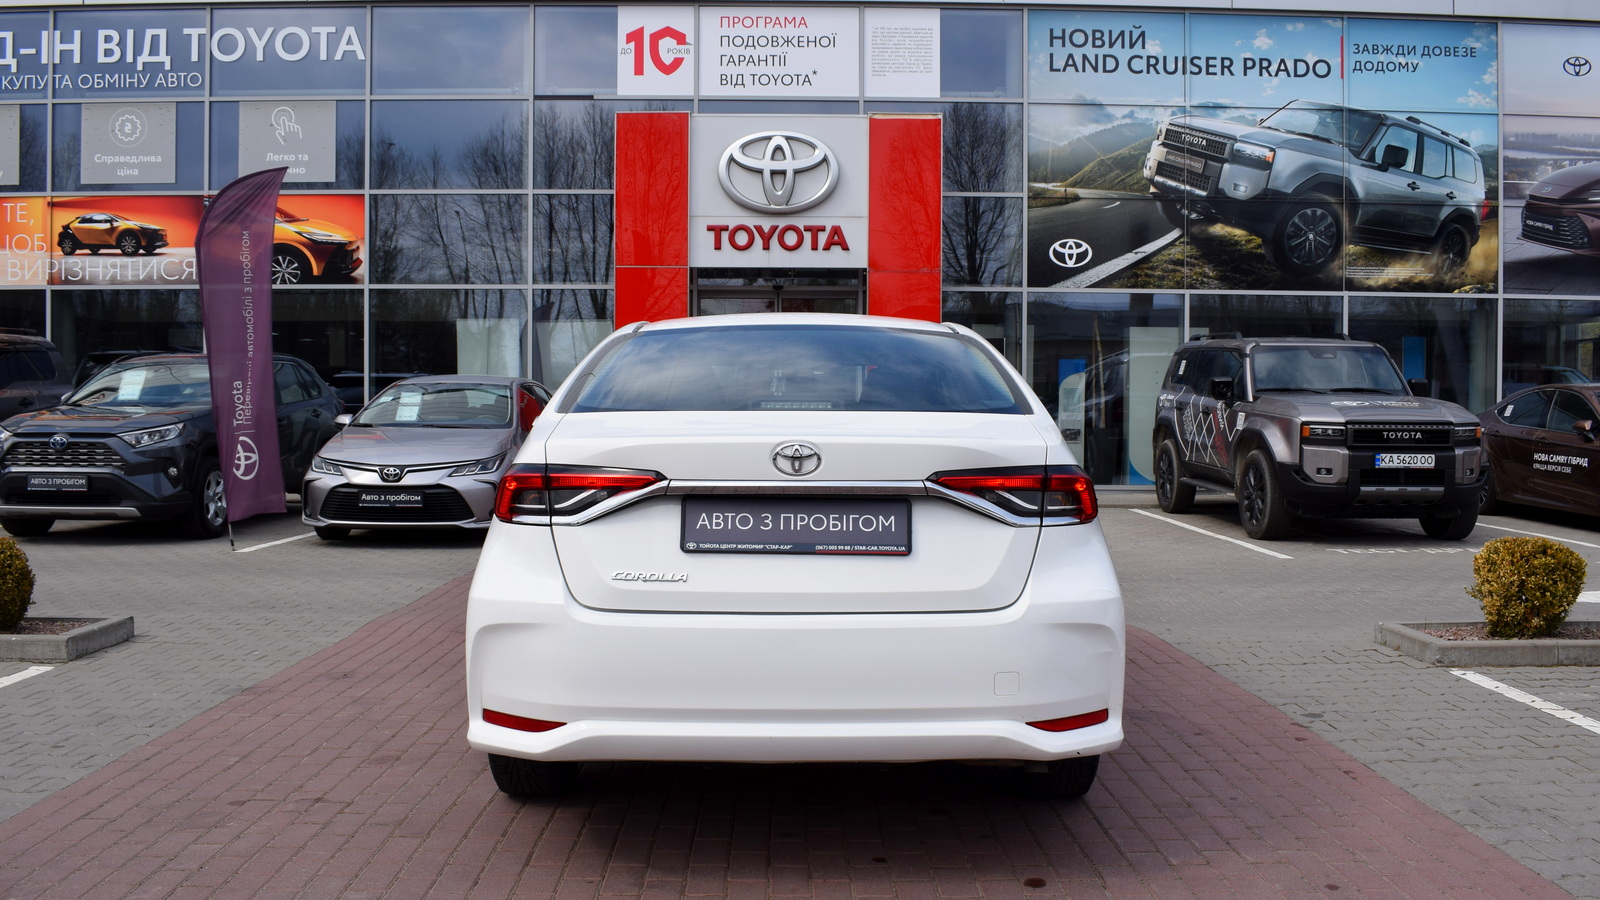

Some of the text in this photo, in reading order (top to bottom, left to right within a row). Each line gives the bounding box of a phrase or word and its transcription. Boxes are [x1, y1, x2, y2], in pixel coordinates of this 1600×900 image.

[720, 16, 808, 29] ПРОГРАМА
[720, 32, 838, 50] ПОДОВЖЕНОЇ
[1049, 24, 1146, 50] НОВИЙ
[97, 28, 172, 71] ВІД
[183, 26, 366, 62] TOYOTA
[1352, 43, 1477, 59] ЗАВЖДИ ДОВЕЗЕ
[720, 51, 788, 67] ГАРАНТІЇ
[1049, 52, 1332, 79] LAND CRUISER PRADO
[1352, 60, 1420, 74] ДОДОМУ
[2, 73, 202, 90] КУПУ ТА ОБМІНУ АВТО
[720, 73, 746, 88] ВІД
[1181, 134, 1206, 145] TOYOTA
[94, 153, 162, 165] Справедлива
[265, 152, 309, 161] Легко та
[117, 166, 139, 177] ціна
[706, 224, 850, 251] TOYOTA
[239, 230, 254, 284] пробігом
[7, 258, 197, 281] ВИРІЗНЯТИСЯ
[232, 380, 246, 427] Toyota
[1383, 431, 1422, 439] TOYOTA
[1381, 455, 1395, 464] KA
[1396, 455, 1419, 465] 5620
[1533, 453, 1588, 467] НОВА CAMRY ГІБРИД
[361, 493, 379, 501] Авто
[386, 493, 421, 502] пробігом
[696, 512, 895, 532] АВТО З ПРОБІГОМ
[611, 571, 689, 583] COROLLA
